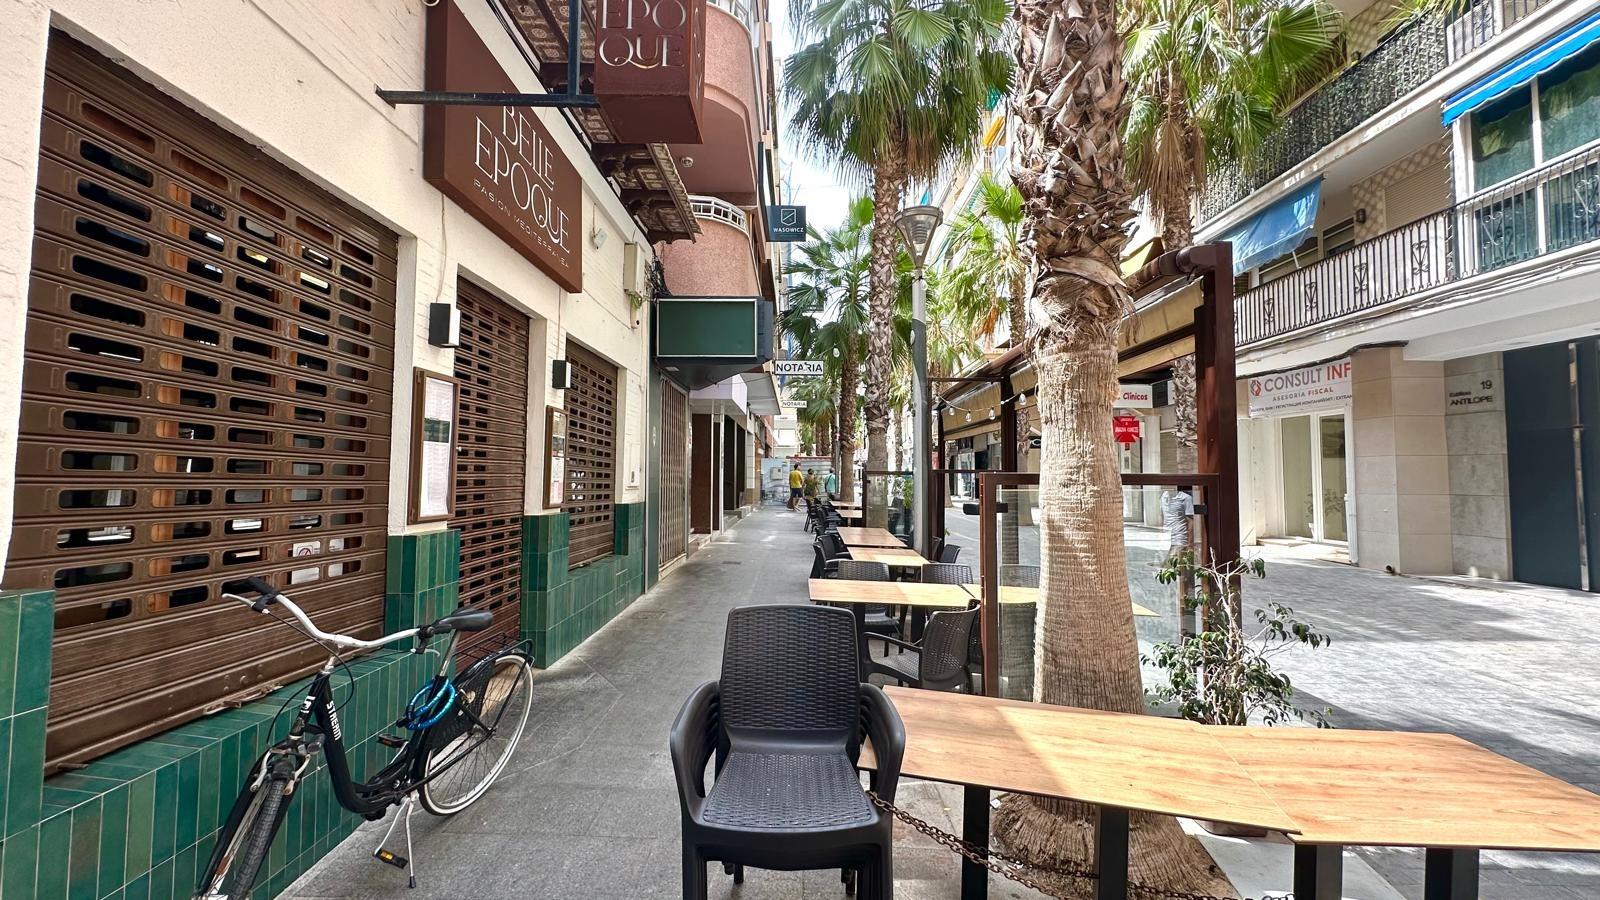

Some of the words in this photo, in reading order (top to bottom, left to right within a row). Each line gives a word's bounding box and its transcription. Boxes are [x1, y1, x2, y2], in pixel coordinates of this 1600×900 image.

[601, 0, 686, 29] EPO
[599, 34, 686, 69] QUE
[502, 91, 555, 191] BELLE
[475, 115, 570, 254] EPOQUE
[1264, 369, 1322, 392] CONSULT
[1308, 387, 1334, 396] FISCAL
[1480, 380, 1492, 389] 19
[1450, 396, 1492, 405] ANTILOPE
